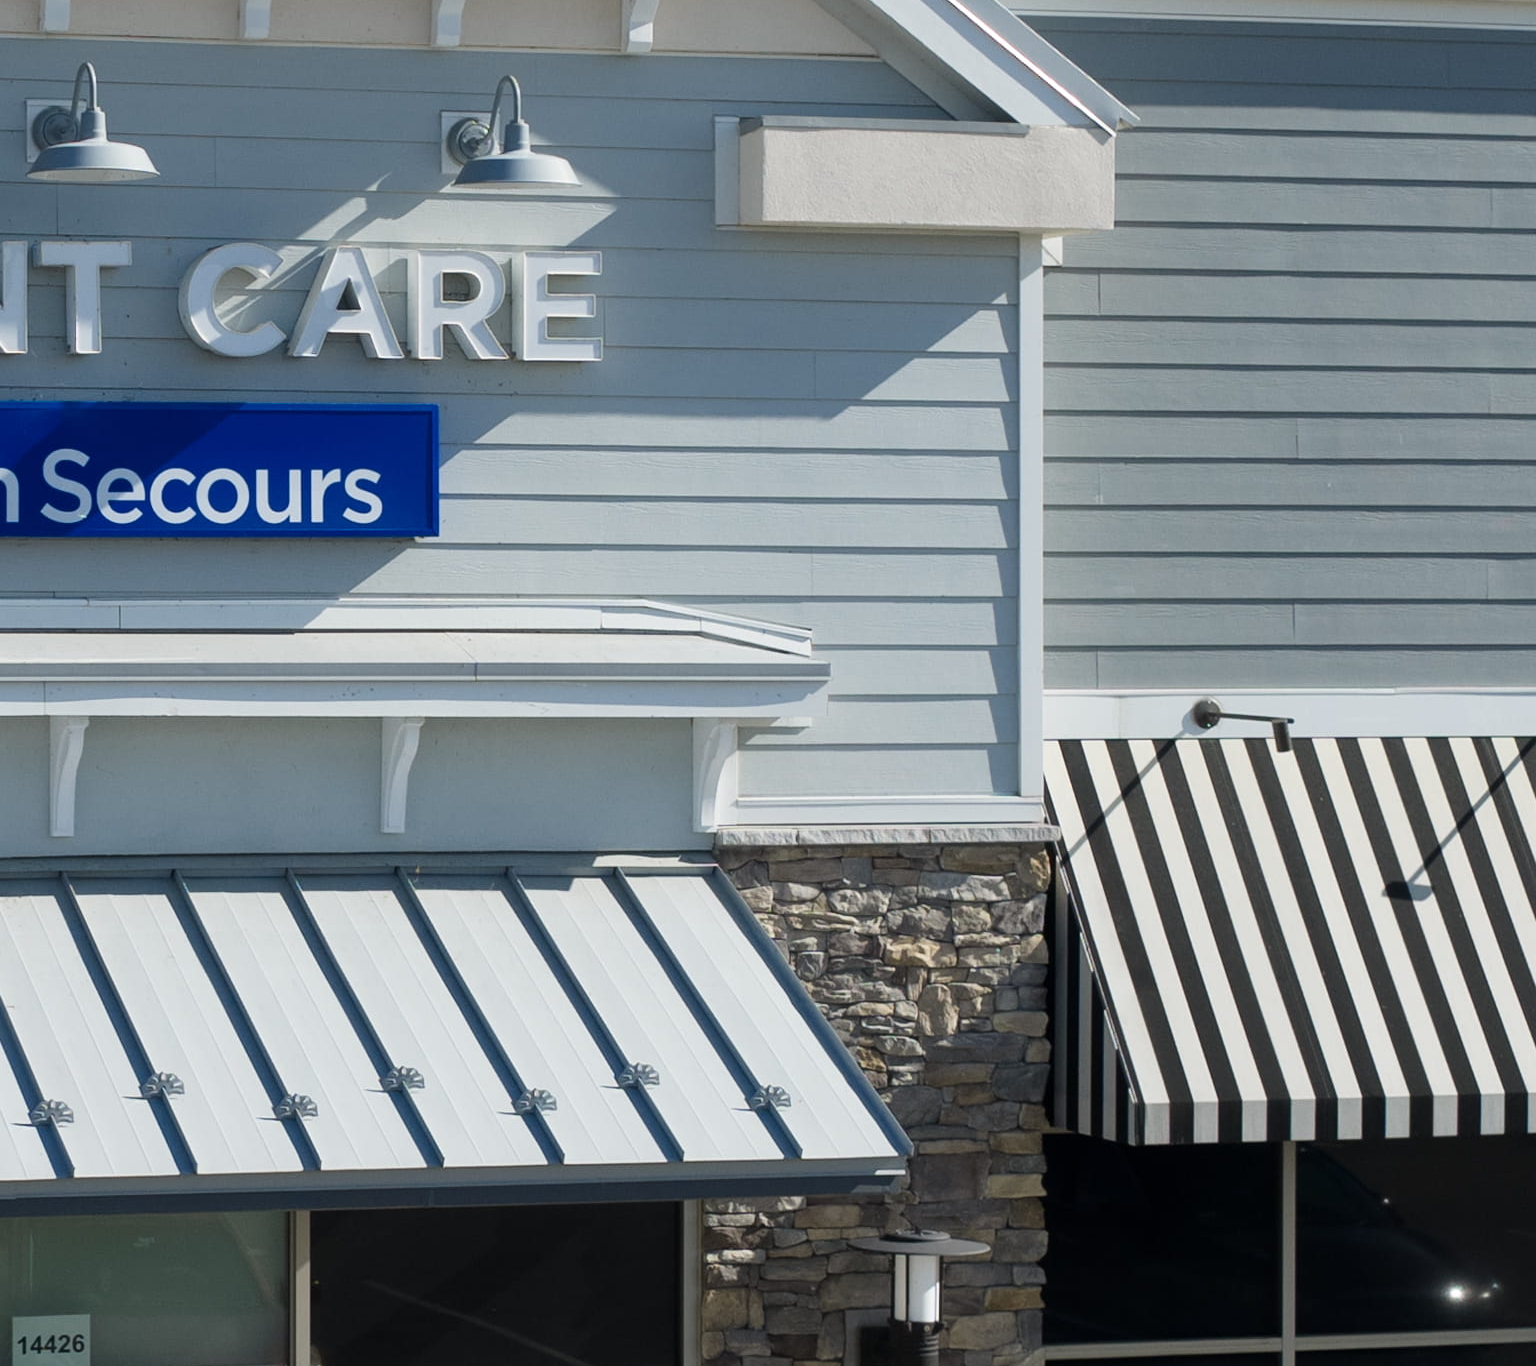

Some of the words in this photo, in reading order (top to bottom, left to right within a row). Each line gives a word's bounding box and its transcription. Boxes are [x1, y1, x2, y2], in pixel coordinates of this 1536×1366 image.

[178, 242, 603, 362] CARE
[39, 447, 383, 524] Secours
[17, 1334, 85, 1355] 14426
